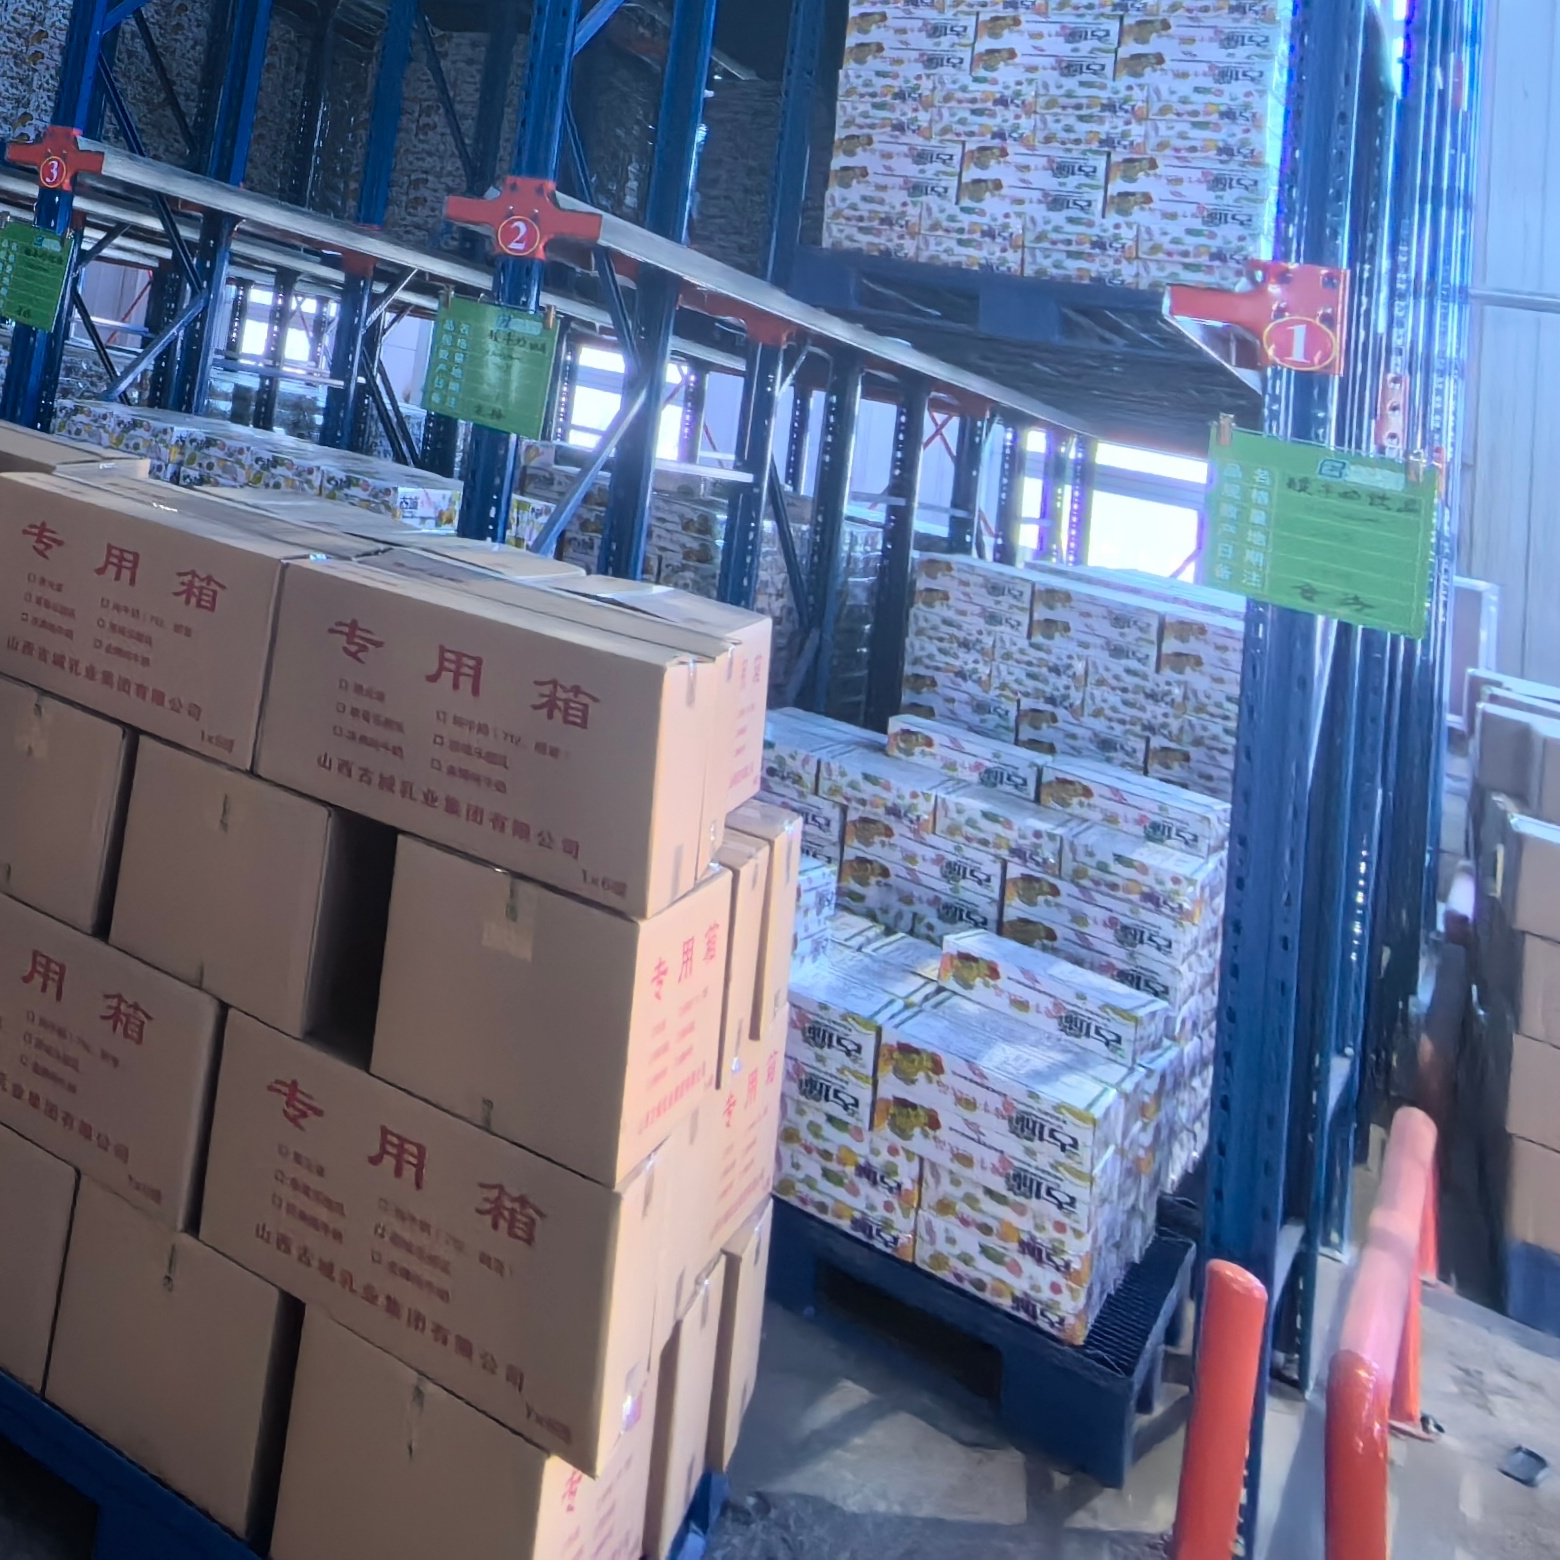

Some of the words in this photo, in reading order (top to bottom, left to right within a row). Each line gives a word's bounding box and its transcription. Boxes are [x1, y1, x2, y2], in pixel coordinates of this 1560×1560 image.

[45, 160, 59, 183] 3
[507, 221, 528, 250] 2
[1286, 323, 1310, 363] 1
[22, 521, 227, 613] 专用箱
[1218, 542, 1265, 570] 日期
[328, 619, 601, 730] 专用箱
[266, 1079, 547, 1247] 专用箱
